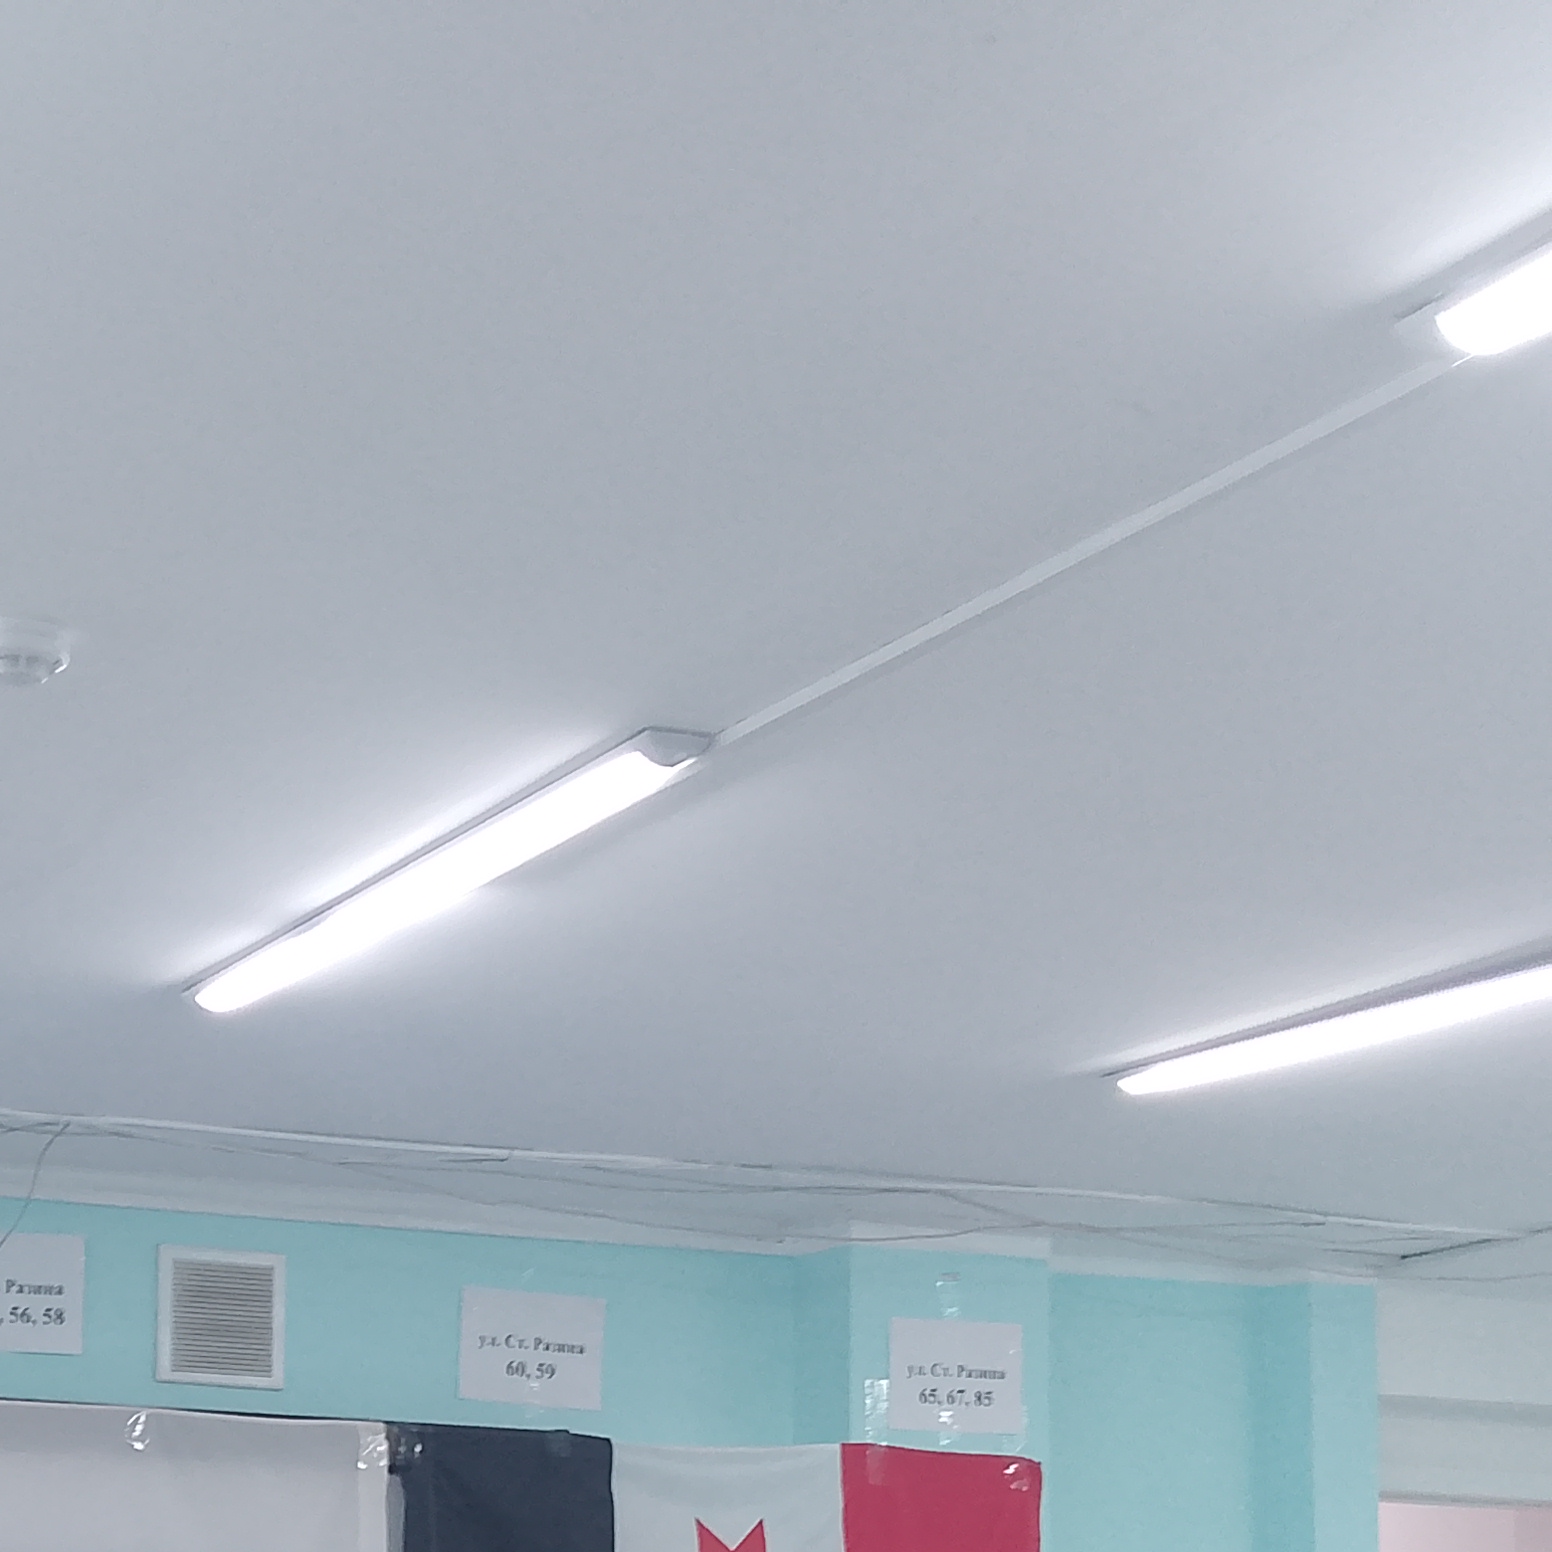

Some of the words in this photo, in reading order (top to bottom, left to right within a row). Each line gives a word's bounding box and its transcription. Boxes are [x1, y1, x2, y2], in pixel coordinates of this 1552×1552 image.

[5, 1279, 65, 1296] Разина
[9, 1306, 37, 1327] 56,
[42, 1307, 66, 1326] 58
[504, 1334, 530, 1350] Ст.
[533, 1337, 586, 1355] Разина
[505, 1360, 531, 1380] 60,
[535, 1362, 557, 1380] 59
[930, 1363, 954, 1378] Ст.
[918, 1388, 942, 1406] 65,
[946, 1389, 970, 1407] 67,
[973, 1391, 995, 1407] 85
